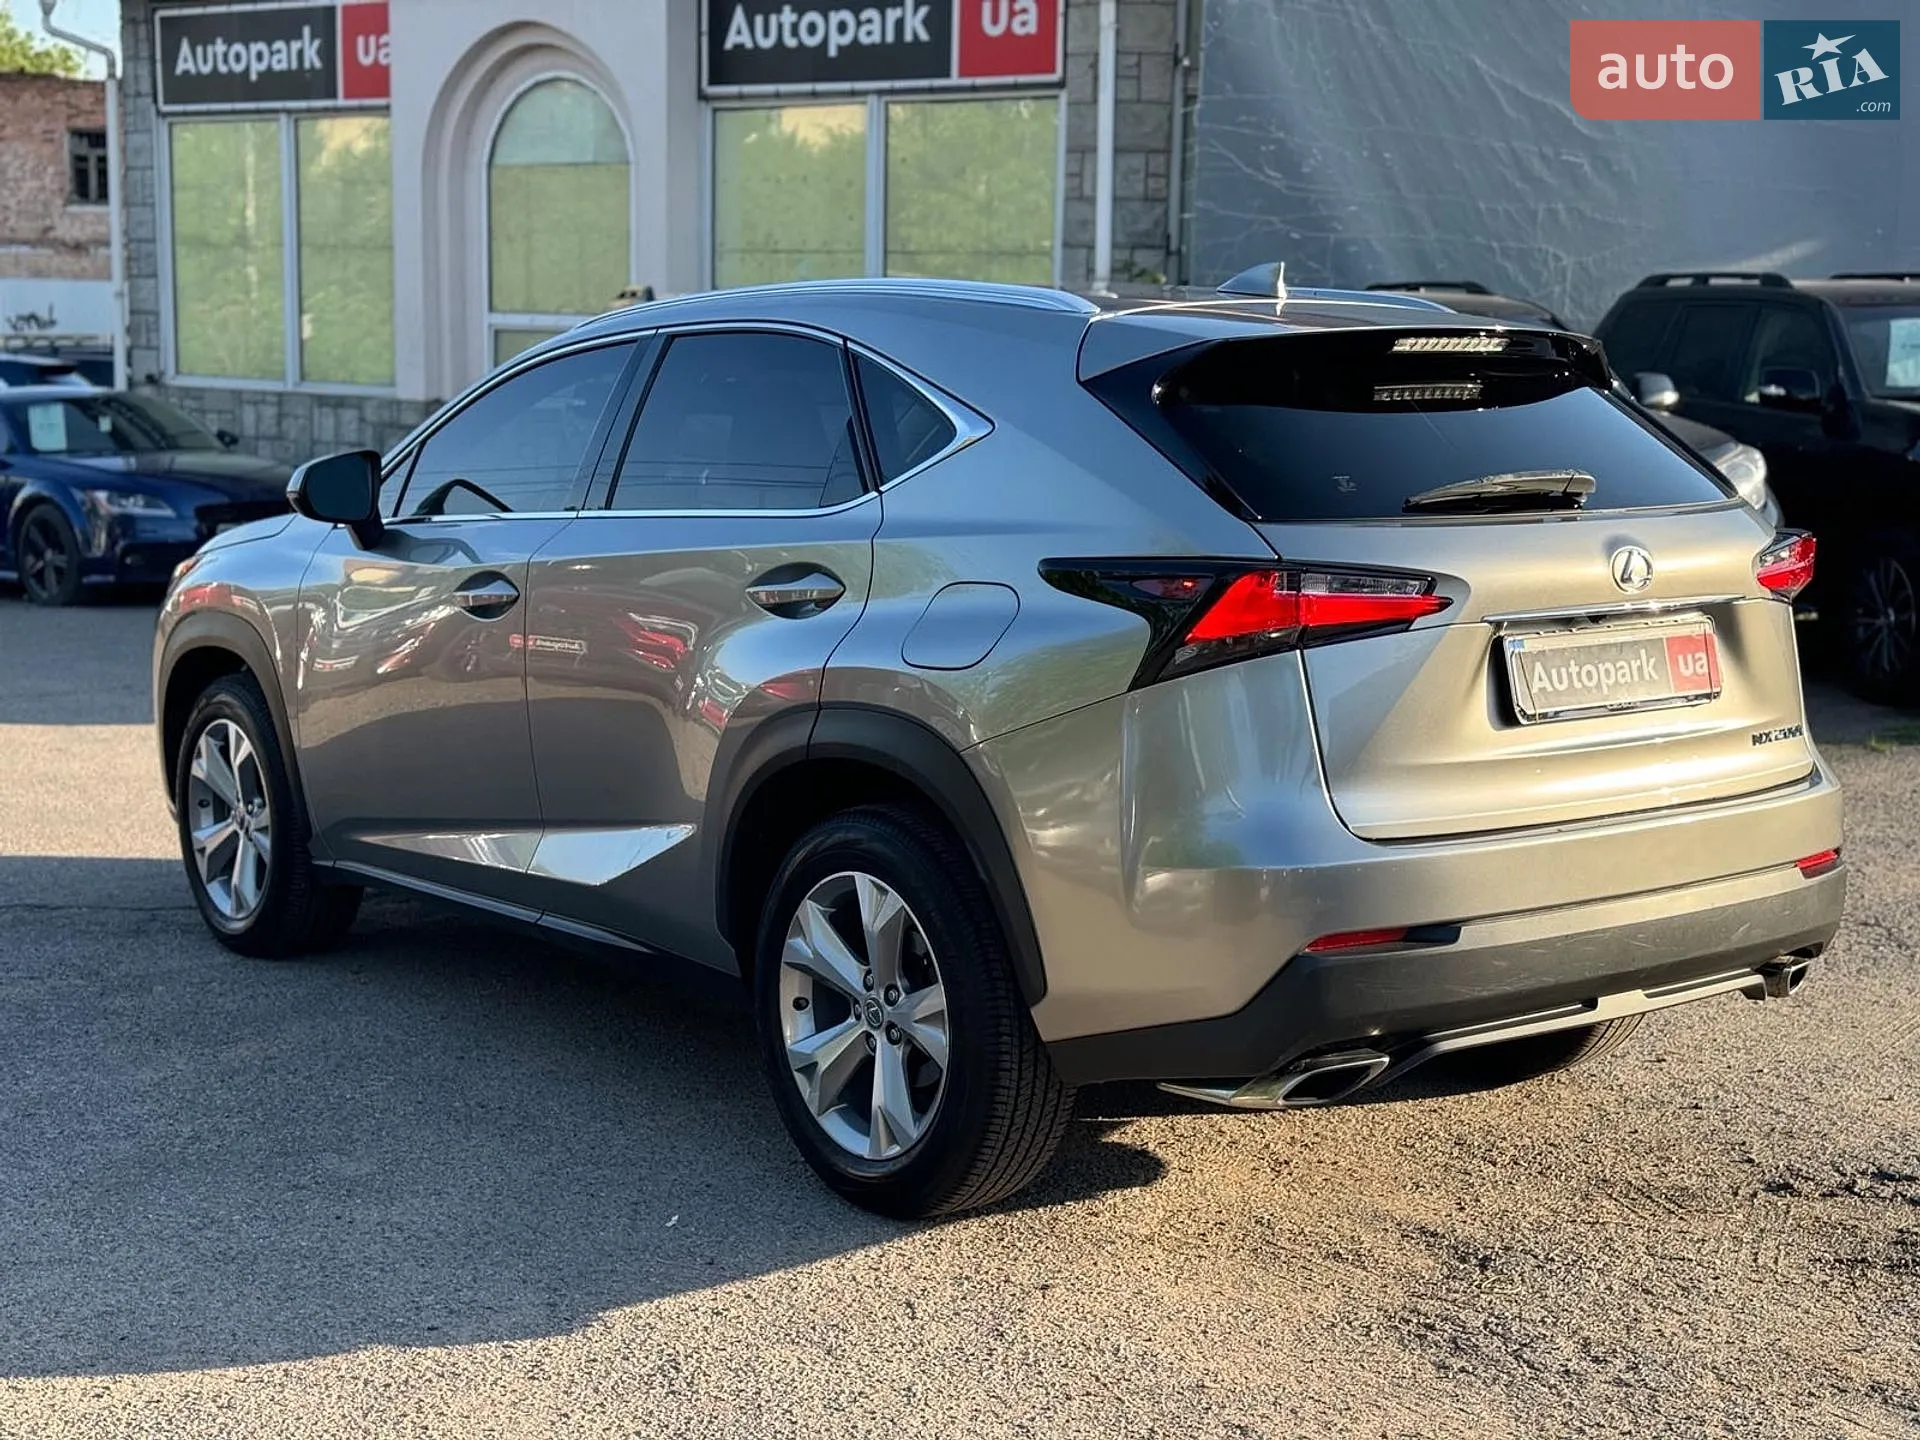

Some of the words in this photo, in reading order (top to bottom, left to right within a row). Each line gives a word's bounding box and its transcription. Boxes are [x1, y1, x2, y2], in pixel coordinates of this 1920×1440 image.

[174, 25, 323, 82] Autopark
[723, 0, 931, 57] Autopark
[981, 0, 1038, 37] ua
[1532, 649, 1659, 695] Autopark
[1677, 651, 1709, 677] ua
